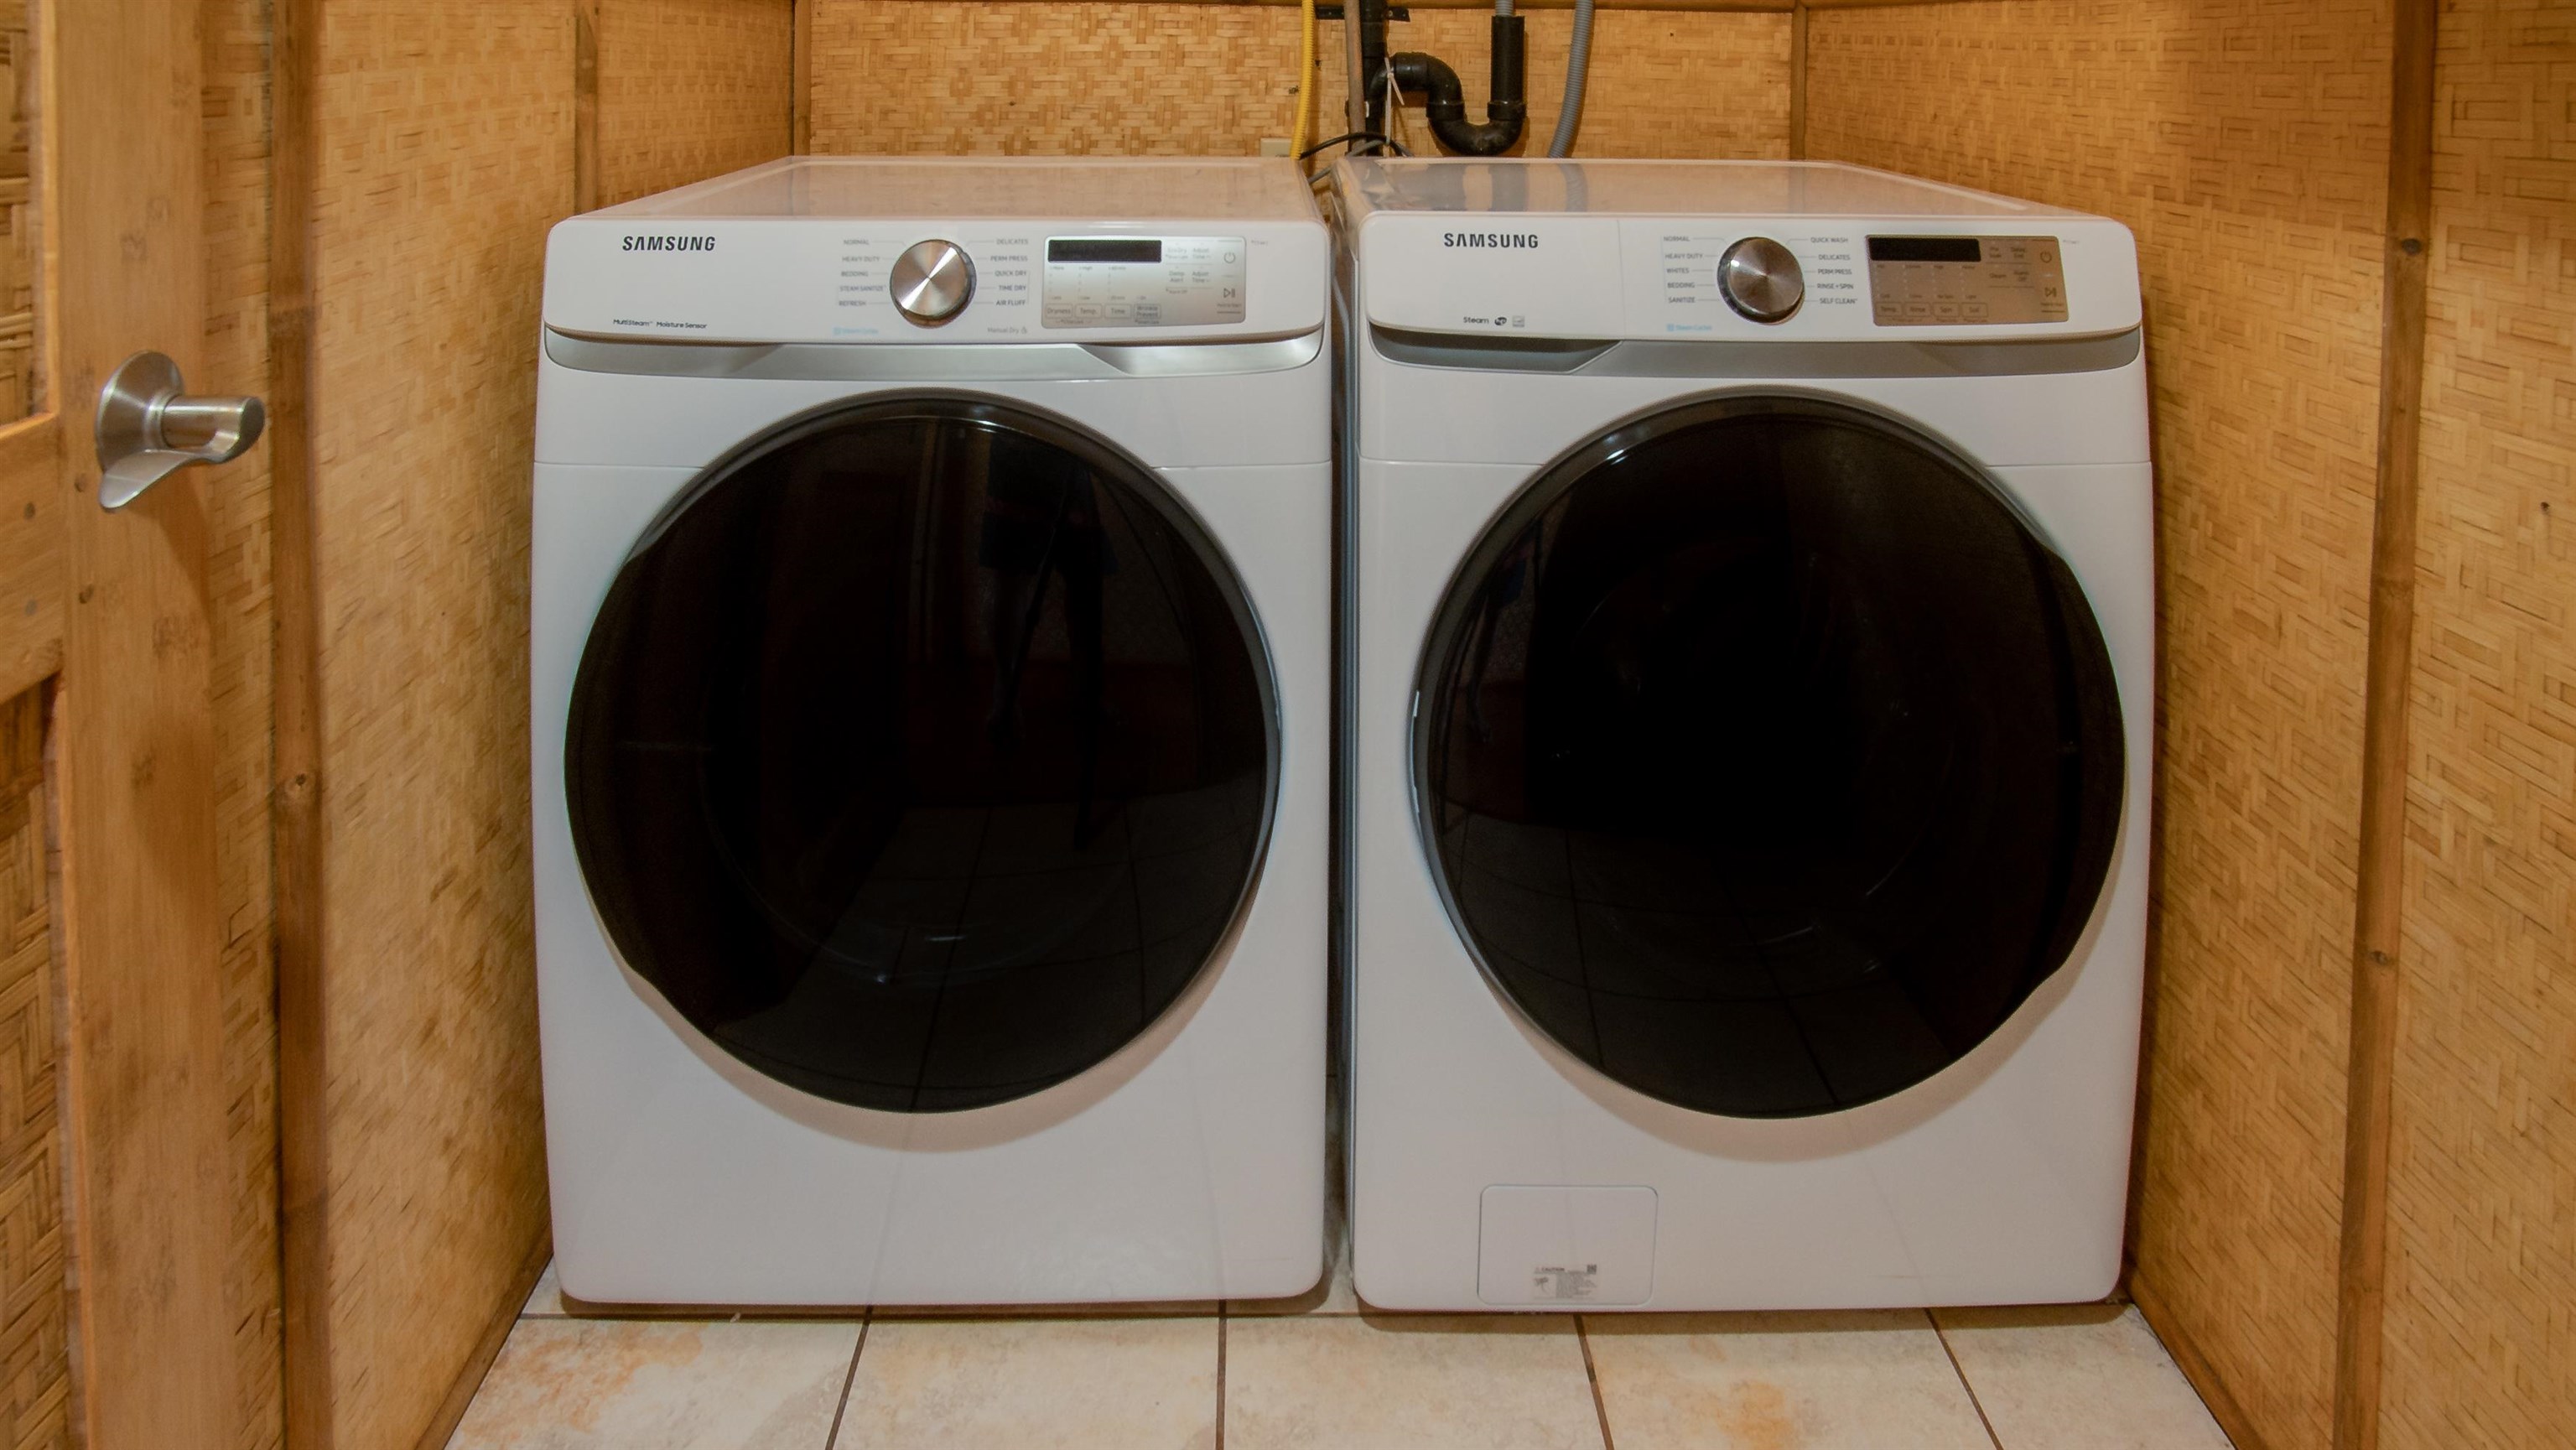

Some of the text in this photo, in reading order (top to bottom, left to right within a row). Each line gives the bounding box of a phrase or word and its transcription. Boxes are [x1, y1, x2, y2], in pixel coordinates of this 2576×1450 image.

[622, 236, 716, 252] SAMSUNG
[1444, 232, 1538, 248] SAMSUNG
[1463, 316, 1488, 325] Steam
